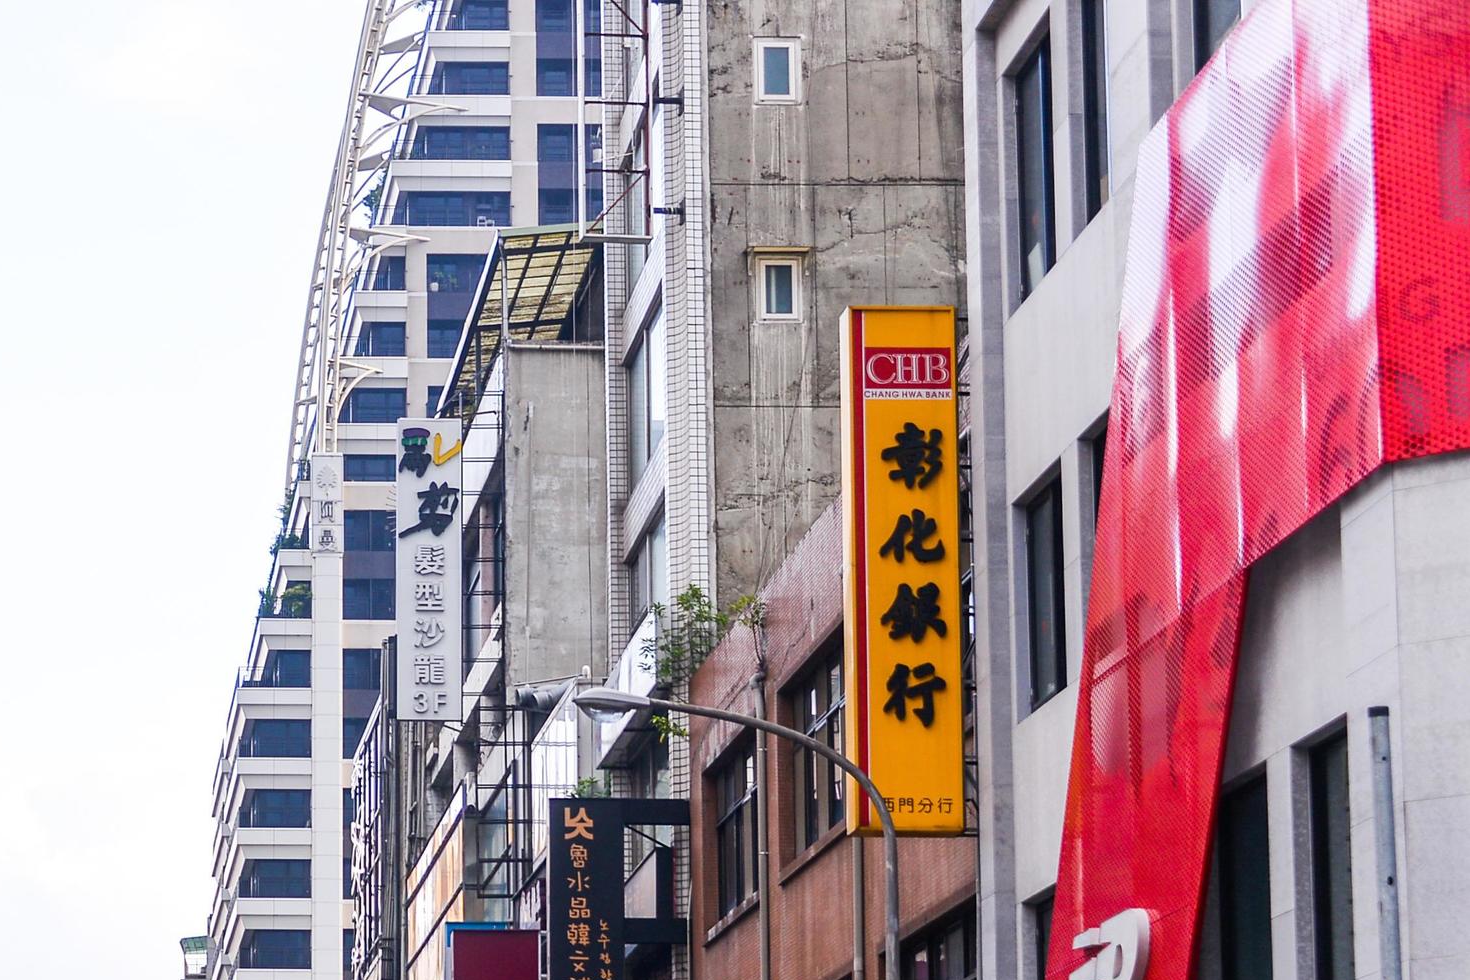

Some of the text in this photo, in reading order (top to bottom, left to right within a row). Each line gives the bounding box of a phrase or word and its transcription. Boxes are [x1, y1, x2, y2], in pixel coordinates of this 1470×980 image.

[866, 353, 950, 385] CHB
[879, 421, 948, 729] 彰化銀行
[414, 544, 447, 714] 髮型沙龍 3F
[883, 797, 953, 813] 西門分行
